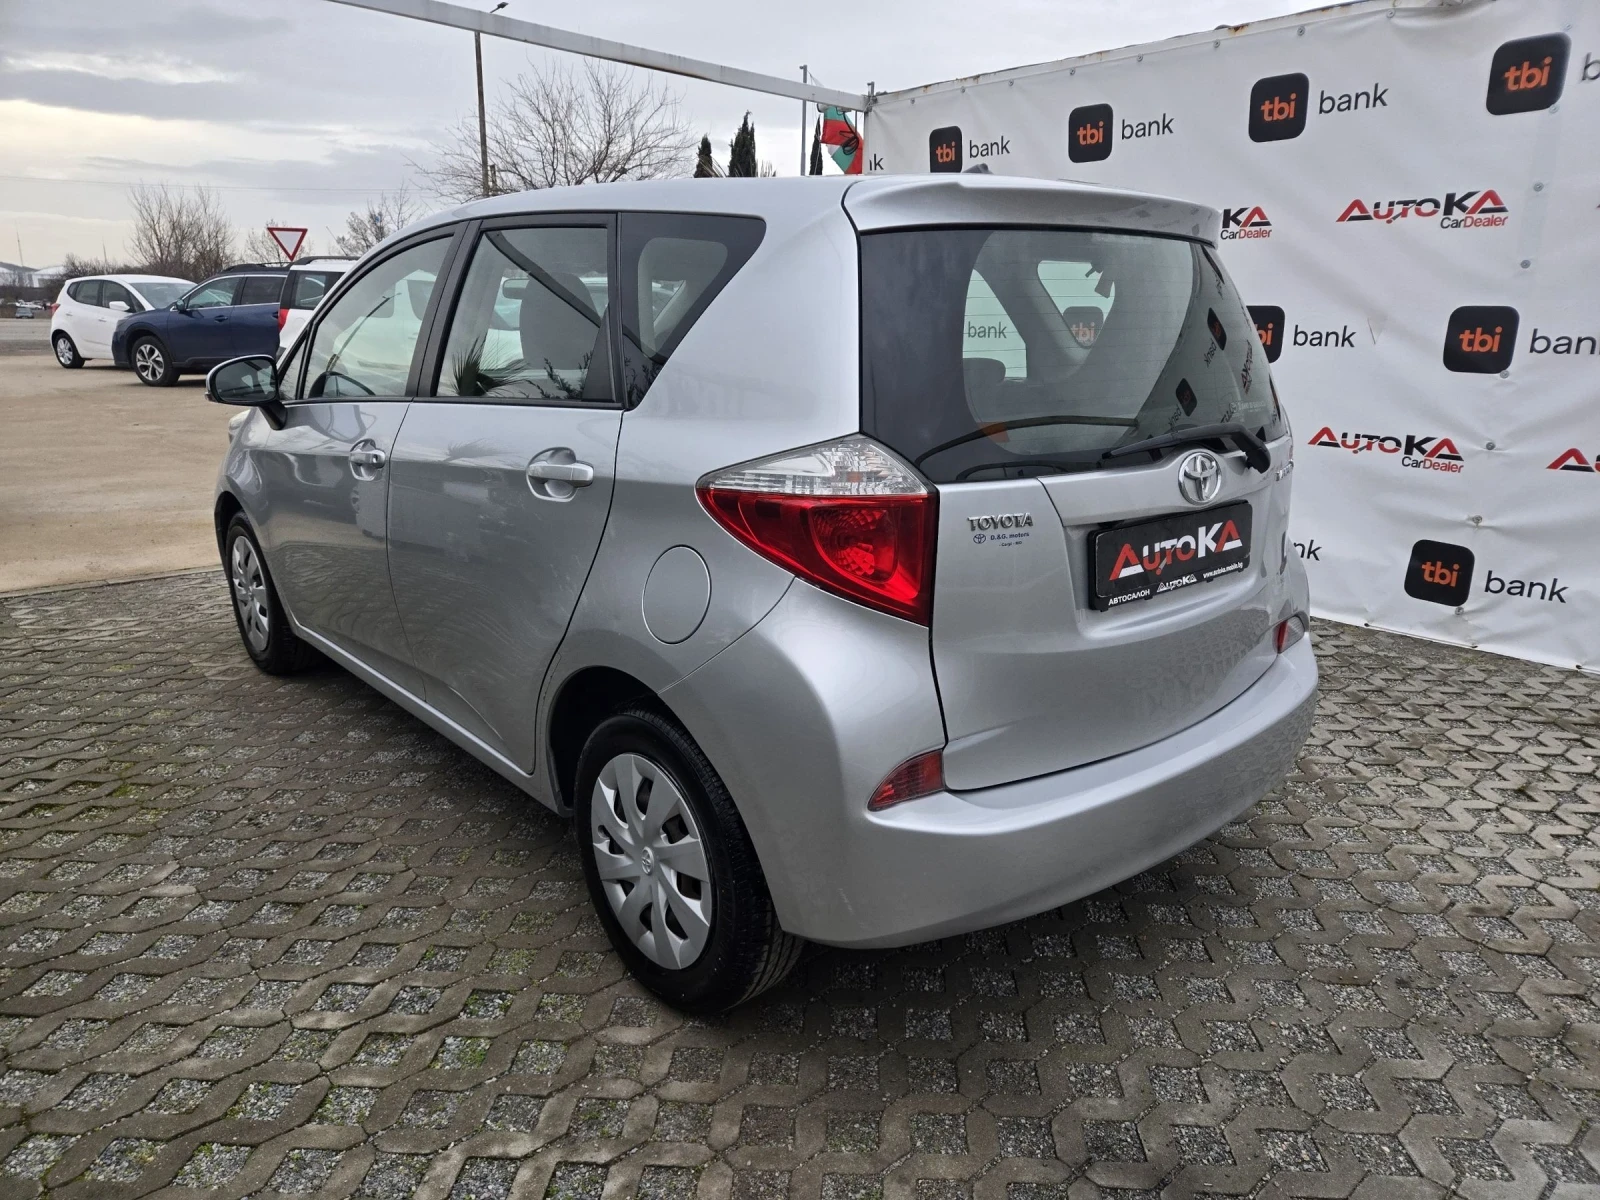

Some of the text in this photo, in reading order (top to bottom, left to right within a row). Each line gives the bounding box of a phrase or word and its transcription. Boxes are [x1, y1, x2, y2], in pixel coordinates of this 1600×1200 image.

[1504, 56, 1553, 91] tbi
[1260, 82, 1389, 122] tbi bank
[1077, 113, 1175, 146] tbi bank
[935, 135, 1011, 163] tbi bank
[1220, 228, 1273, 241] CarDealer
[1440, 214, 1509, 230] CarDealer
[967, 321, 1008, 339] bank
[1254, 322, 1357, 348] bi bank
[1458, 326, 1600, 356] tbi ban
[1401, 456, 1464, 474] CarDealer
[967, 512, 1034, 532] TOYOTA
[1293, 539, 1323, 562] nk
[1421, 559, 1570, 604] tbi bank
